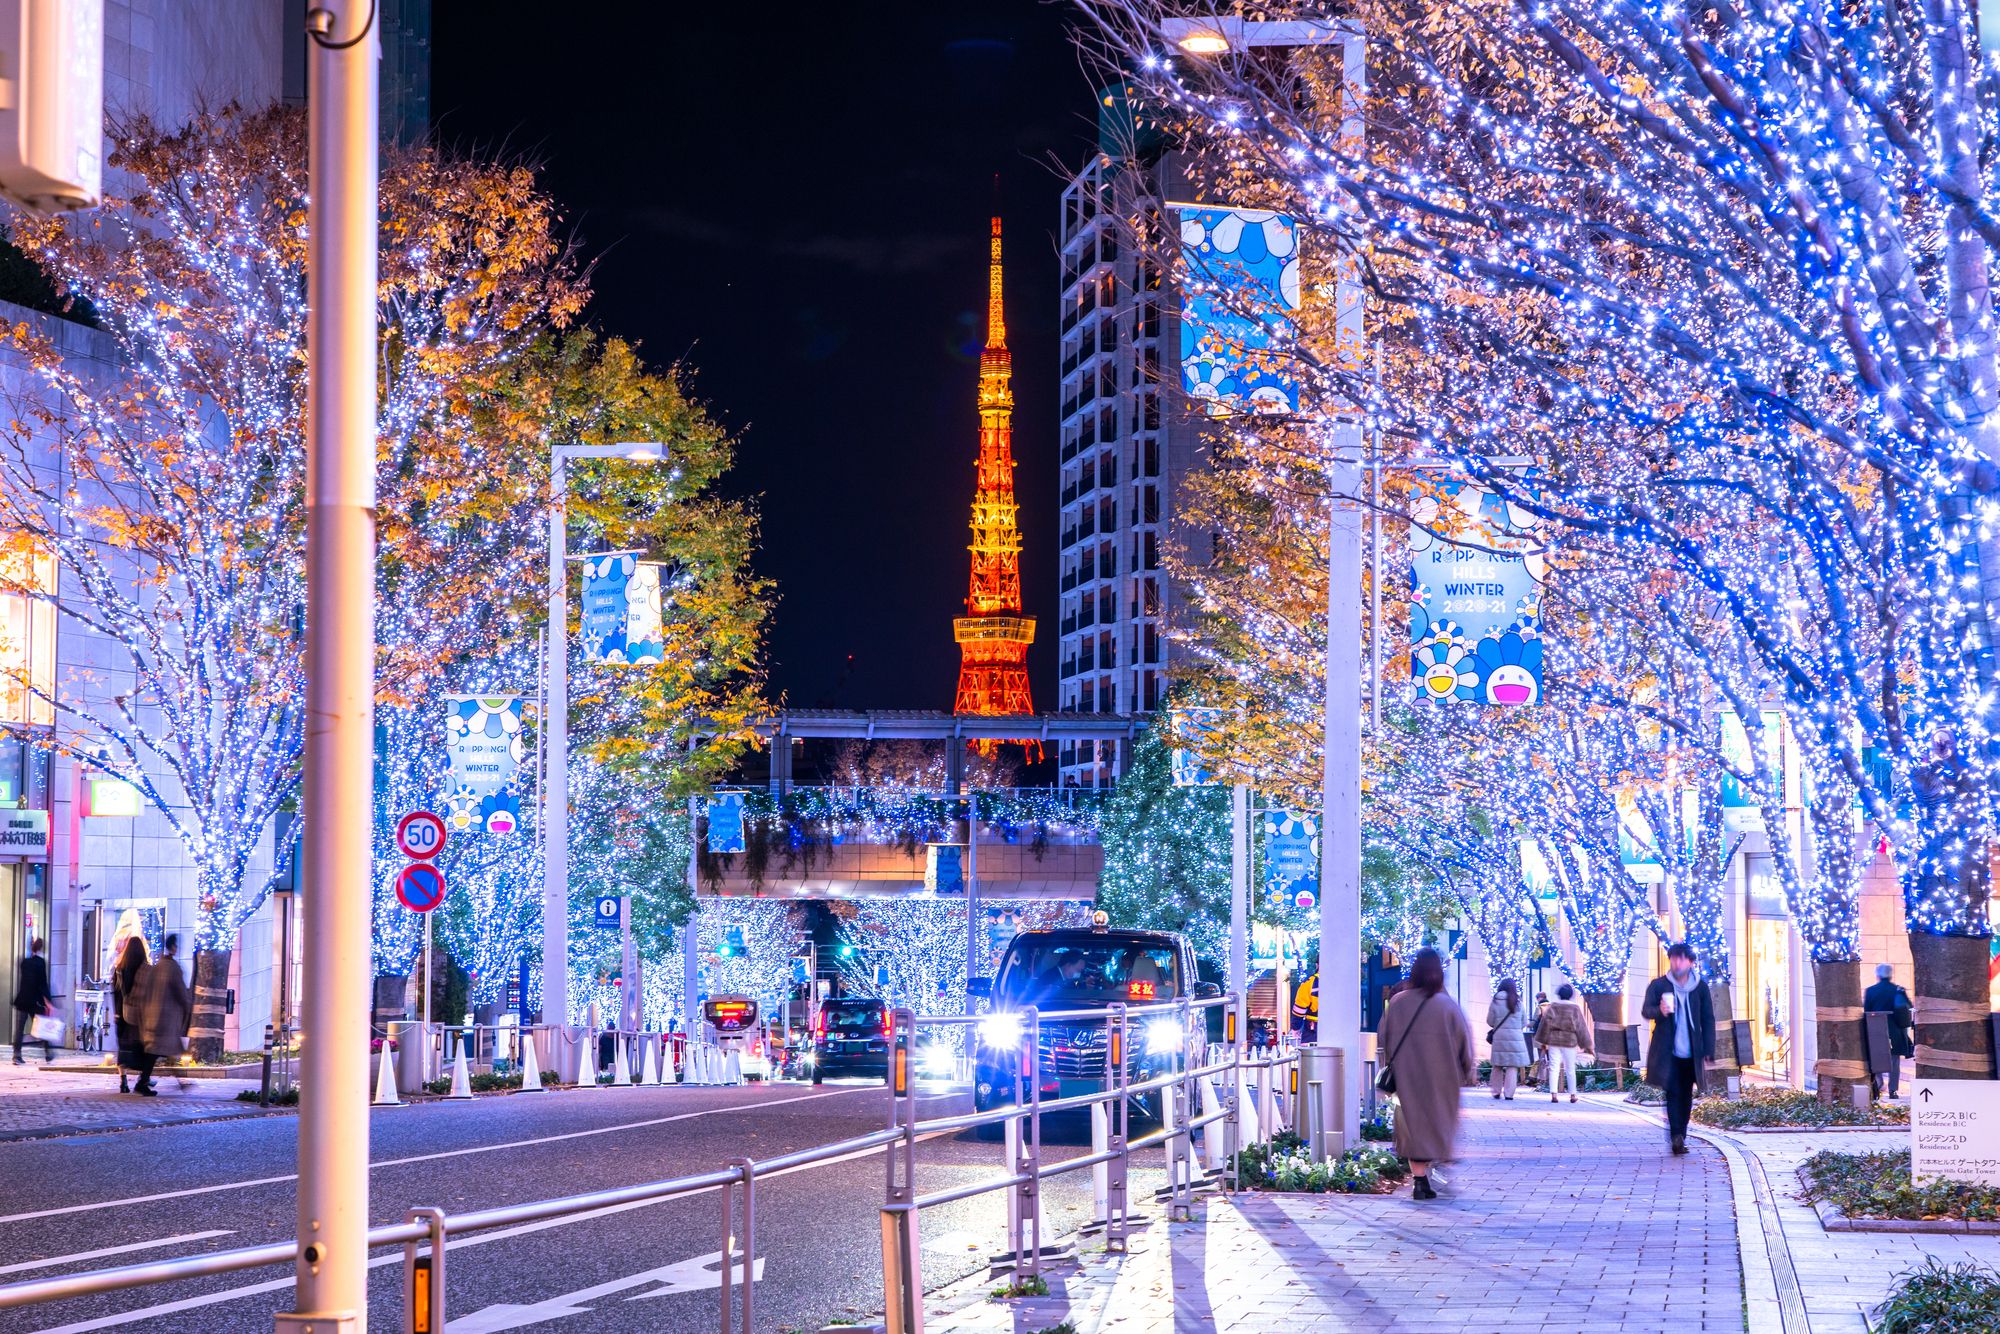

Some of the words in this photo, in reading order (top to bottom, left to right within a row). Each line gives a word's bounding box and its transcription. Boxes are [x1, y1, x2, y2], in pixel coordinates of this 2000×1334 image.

[1453, 566, 1496, 579] HILLS
[1445, 583, 1504, 596] WINTER
[596, 597, 613, 605] HILLS
[1443, 599, 1506, 613] 2020-21
[592, 606, 616, 614] WINTER
[459, 745, 507, 753] ROPPONGI
[464, 774, 500, 782] 2020-21
[0, 831, 46, 845] 本木六丁目交番
[408, 825, 435, 846] 50
[1130, 982, 1154, 995] 支払
[1918, 1111, 1956, 1119] レジデンス
